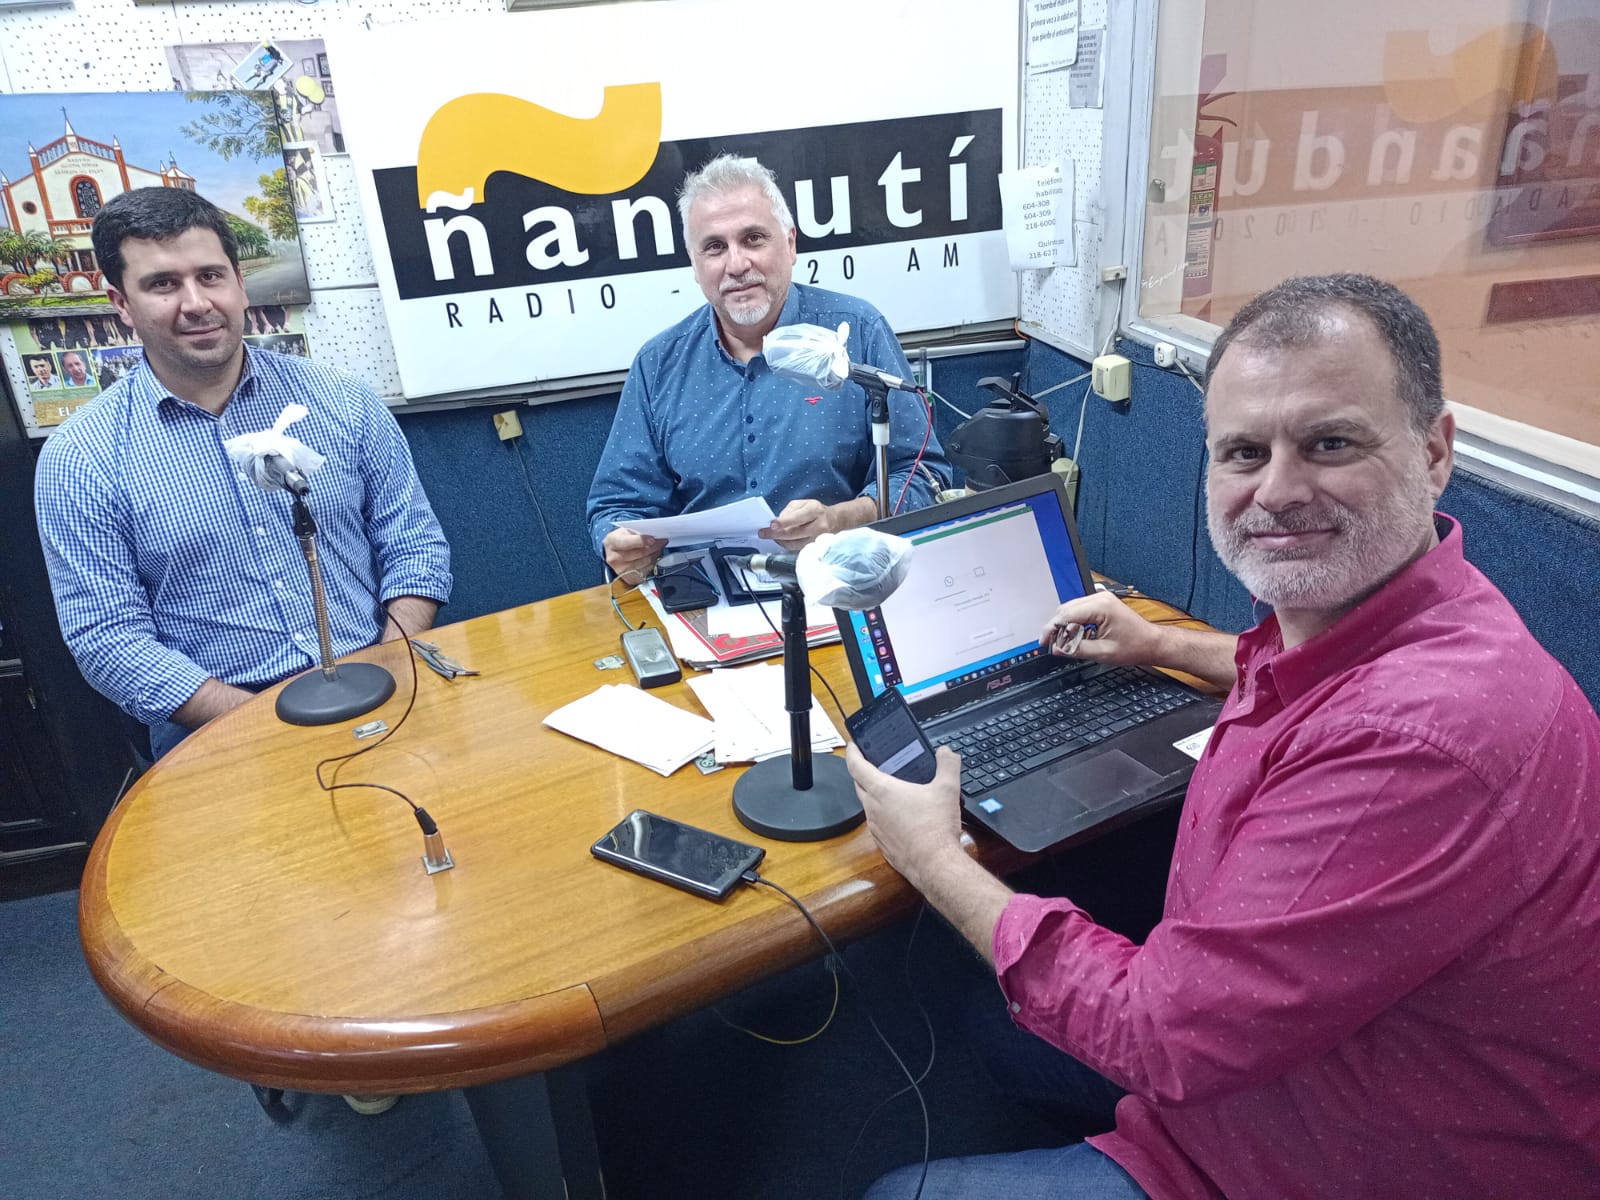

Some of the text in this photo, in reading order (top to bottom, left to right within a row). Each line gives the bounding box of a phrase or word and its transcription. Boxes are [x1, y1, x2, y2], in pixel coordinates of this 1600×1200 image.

[423, 134, 976, 281] ñanutí
[445, 283, 616, 328] RADIO
[907, 241, 959, 272] AM
[986, 674, 1012, 692] ASUS
